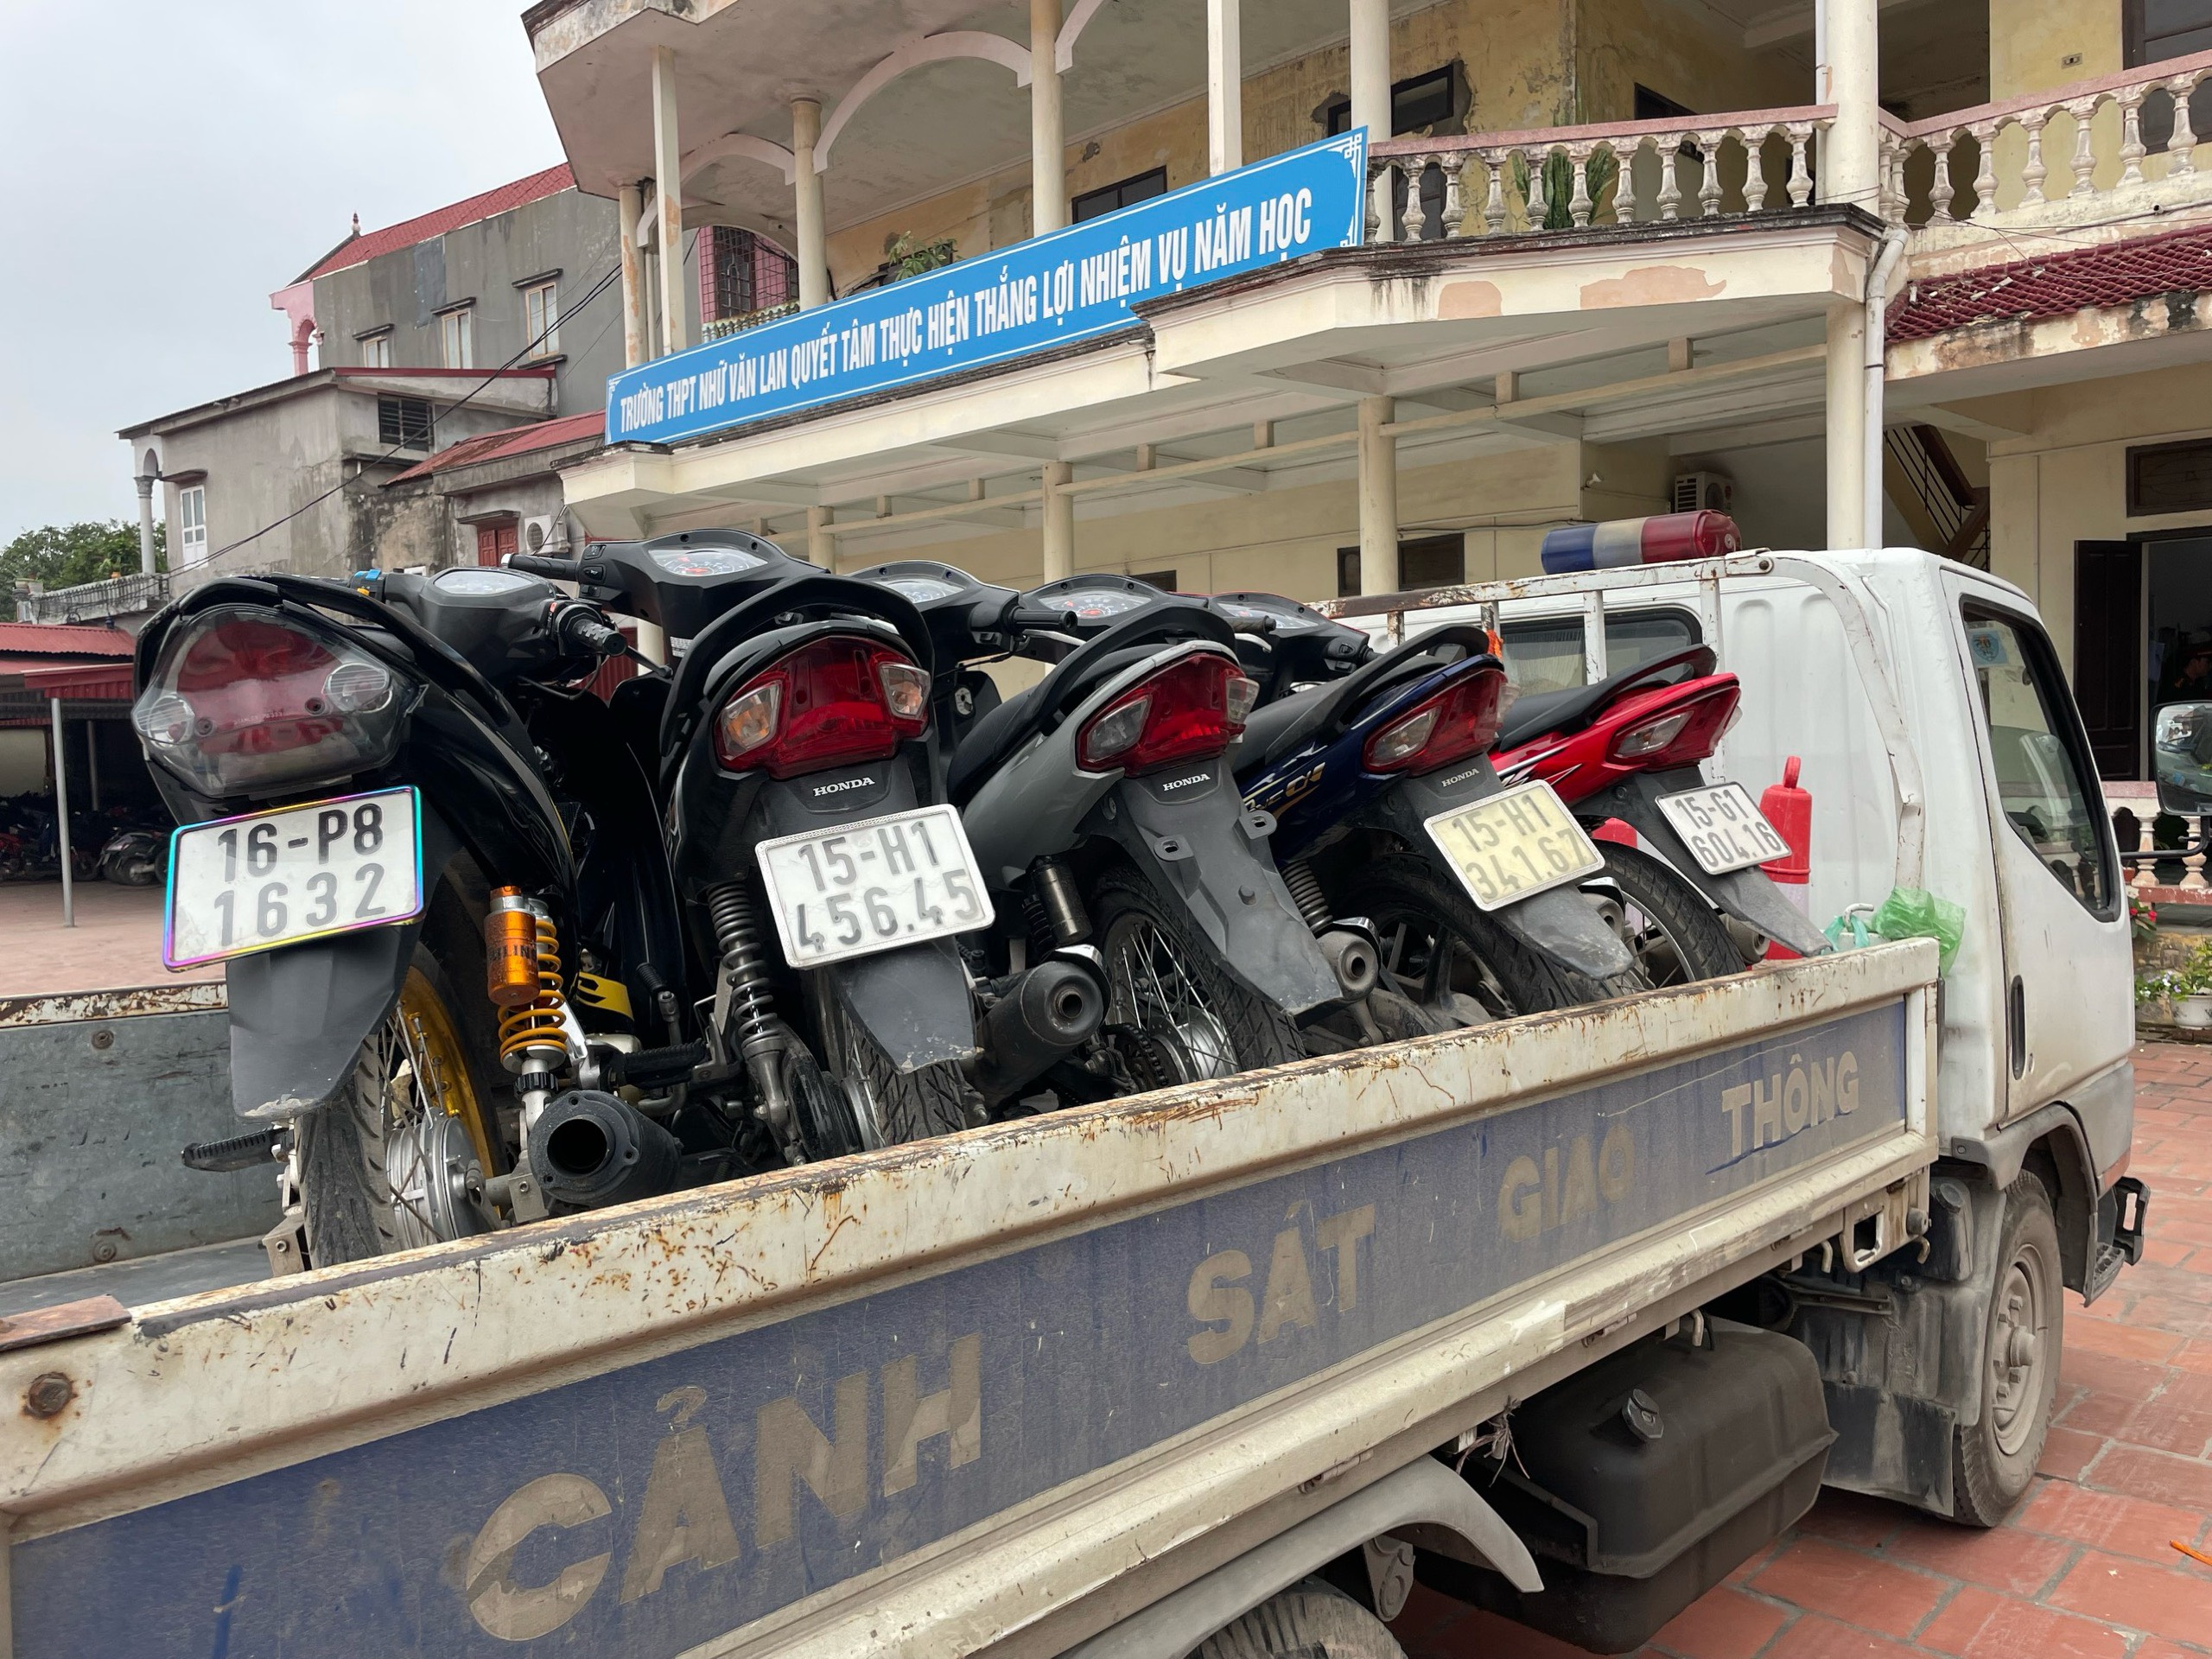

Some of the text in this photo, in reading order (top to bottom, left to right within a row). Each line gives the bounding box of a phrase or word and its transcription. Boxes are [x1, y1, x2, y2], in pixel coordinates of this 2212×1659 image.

[620, 187, 1313, 434] TRƯỜNG THPT NHỮ VĂN LAN QUYẾT TÂM THỰC HIỆN THẮNG LỢI NHIỆM VỤ NĂM HỌC
[812, 776, 876, 797] HONDA
[1162, 773, 1211, 791] HONDA
[1440, 767, 1480, 788] HONDA
[1674, 789, 1750, 830] 15-G1
[216, 802, 385, 883] 16-P8
[798, 820, 939, 892] 15-H1
[1452, 793, 1551, 853] 15-H1
[1690, 821, 1783, 868] 604.16
[1465, 827, 1586, 899] 341.67
[213, 861, 386, 947] 1632
[797, 868, 981, 953] 456.45
[465, 1051, 1859, 1643] CẢNH SÁT GIAO THÔNG
